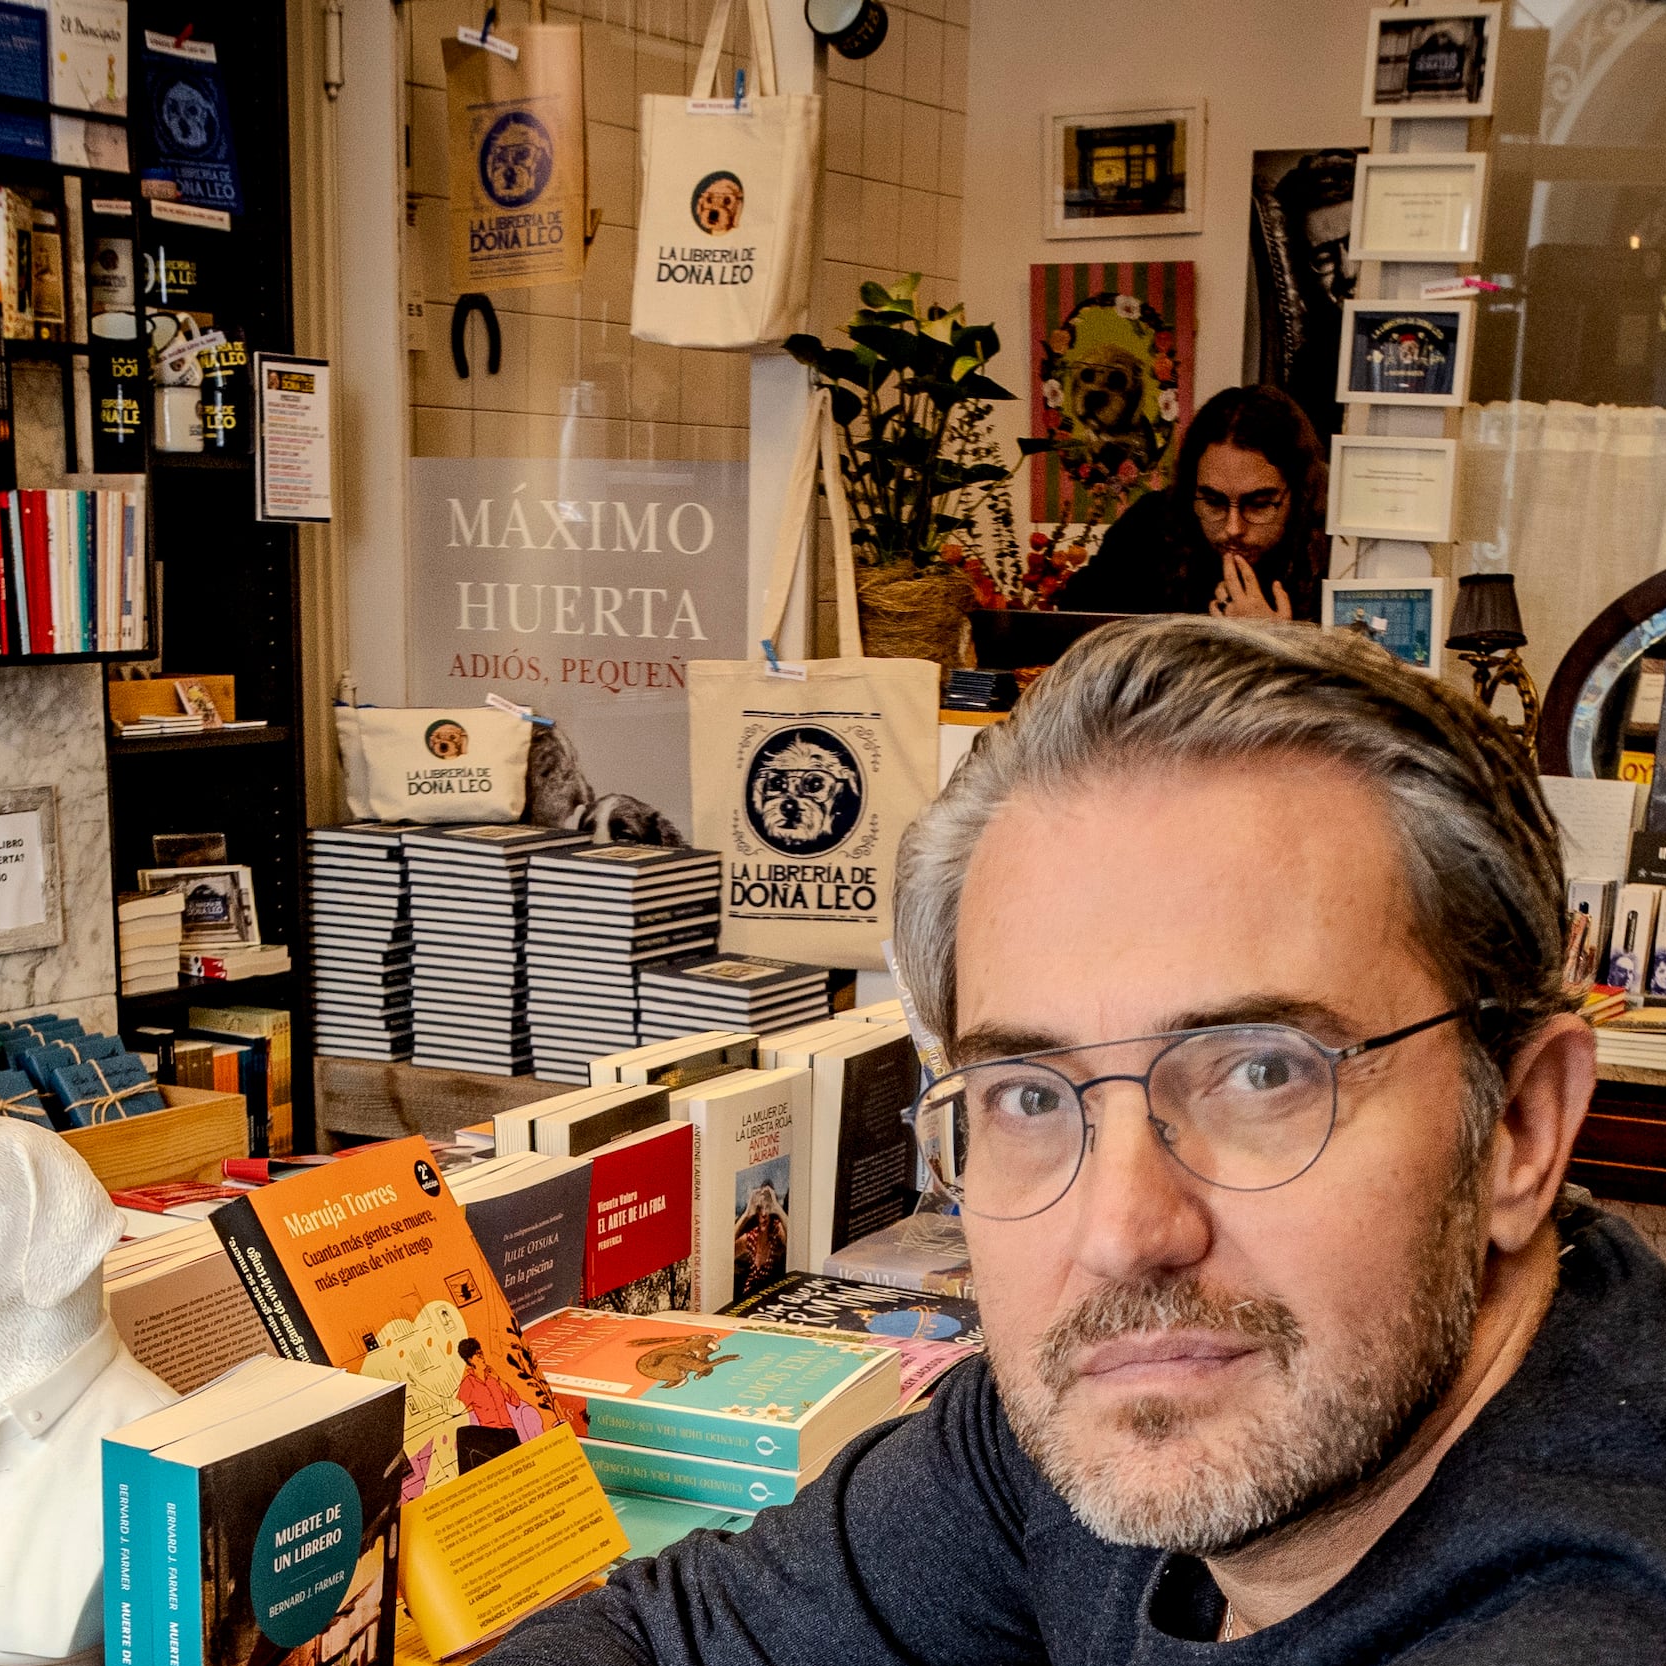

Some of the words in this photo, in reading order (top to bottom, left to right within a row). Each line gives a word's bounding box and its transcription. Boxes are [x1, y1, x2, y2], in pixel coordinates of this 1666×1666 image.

[470, 218, 486, 234] LA
[547, 210, 563, 225] DE
[526, 225, 563, 247] LEO
[656, 263, 716, 285] DOÑA
[719, 264, 753, 285] LEO
[446, 482, 714, 554] MÁXIMO
[455, 581, 709, 641] HUERTA
[448, 649, 549, 687] ADIÓS,
[561, 655, 687, 694] PEQUEÑ
[735, 1129, 746, 1143] LA
[746, 1121, 775, 1140] LIBRETA
[775, 1116, 793, 1130] ROJA
[742, 1113, 752, 1127] LA
[753, 1106, 776, 1125] MUJER
[777, 1101, 789, 1116] DE
[748, 1131, 780, 1151] ANTOINE
[749, 1146, 780, 1165] LAURAIN
[283, 1199, 349, 1239] Maruja
[341, 1182, 398, 1214] Torres
[597, 1197, 619, 1214] Vicente
[619, 1191, 638, 1207] Valero
[597, 1218, 606, 1235] EL
[608, 1212, 627, 1231] ARTE
[628, 1208, 638, 1224] DE
[639, 1203, 648, 1219] LA
[649, 1195, 667, 1215] FUGA
[302, 1243, 342, 1268] Cuanta
[340, 1234, 363, 1257] más
[362, 1225, 391, 1250] gente
[391, 1219, 405, 1235] se
[403, 1208, 437, 1229] muere,
[504, 1245, 525, 1266] JULIE
[527, 1233, 560, 1255] OTSUKA
[314, 1270, 339, 1292] más
[338, 1257, 370, 1288] ganas
[369, 1250, 384, 1271] de
[382, 1244, 406, 1266] vivir
[403, 1237, 433, 1262] tengo
[504, 1274, 517, 1288] En
[518, 1269, 525, 1281] la
[526, 1258, 554, 1283] piscina
[596, 1413, 638, 1431] CONEJO
[656, 1423, 676, 1437] ERA
[679, 1427, 705, 1442] DIOS
[706, 1430, 750, 1448] CUANDO
[118, 1483, 130, 1535] BERNARD
[119, 1535, 129, 1544] J.
[166, 1502, 177, 1553] BERNARD
[274, 1511, 323, 1549] MUERTE
[325, 1503, 342, 1521] DE
[167, 1555, 176, 1563] J.
[274, 1554, 292, 1574] UN
[294, 1527, 343, 1565] LIBRERO
[120, 1548, 130, 1591] FARMER
[167, 1567, 178, 1610] FARMER
[268, 1589, 307, 1619] BERNARD
[307, 1588, 314, 1599] J.
[314, 1570, 345, 1594] FARMER
[120, 1602, 131, 1648] MUERTE
[122, 1650, 132, 1665] DE
